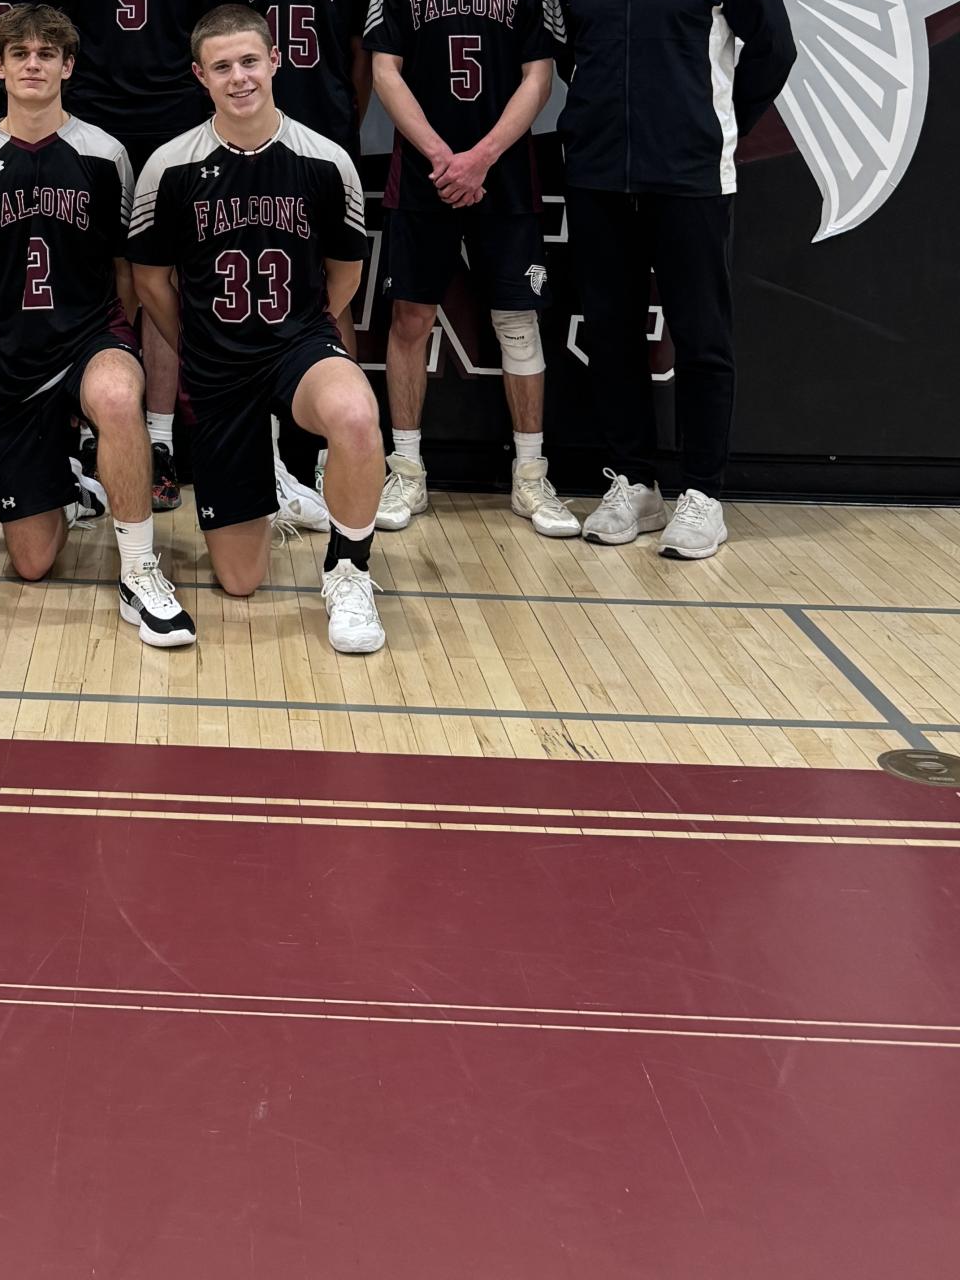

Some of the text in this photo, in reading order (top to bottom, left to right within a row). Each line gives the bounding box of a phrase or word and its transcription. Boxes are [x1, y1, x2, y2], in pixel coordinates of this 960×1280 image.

[266, 4, 320, 68] 15
[448, 35, 483, 102] 5
[193, 195, 311, 242] FALCONS
[21, 236, 55, 311] 2
[212, 248, 291, 324] 33
